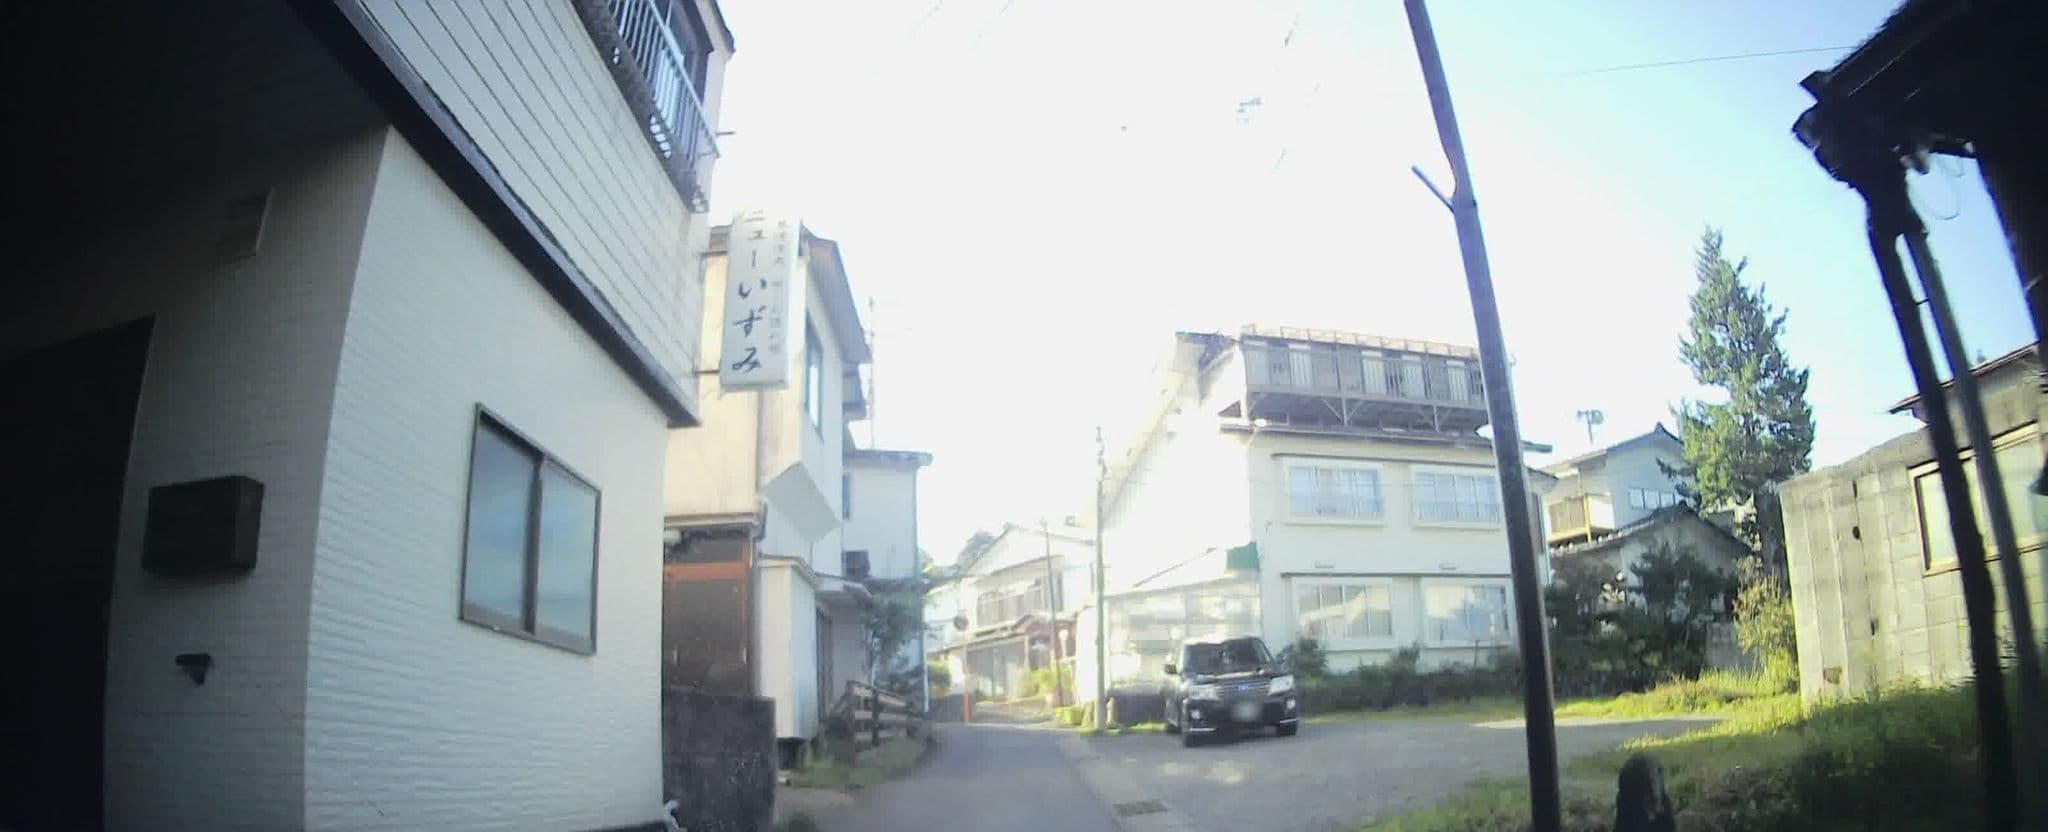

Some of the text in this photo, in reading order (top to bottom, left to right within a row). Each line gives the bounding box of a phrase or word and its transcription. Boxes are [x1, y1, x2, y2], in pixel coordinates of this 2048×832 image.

[731, 209, 768, 373] ニューいずみ
